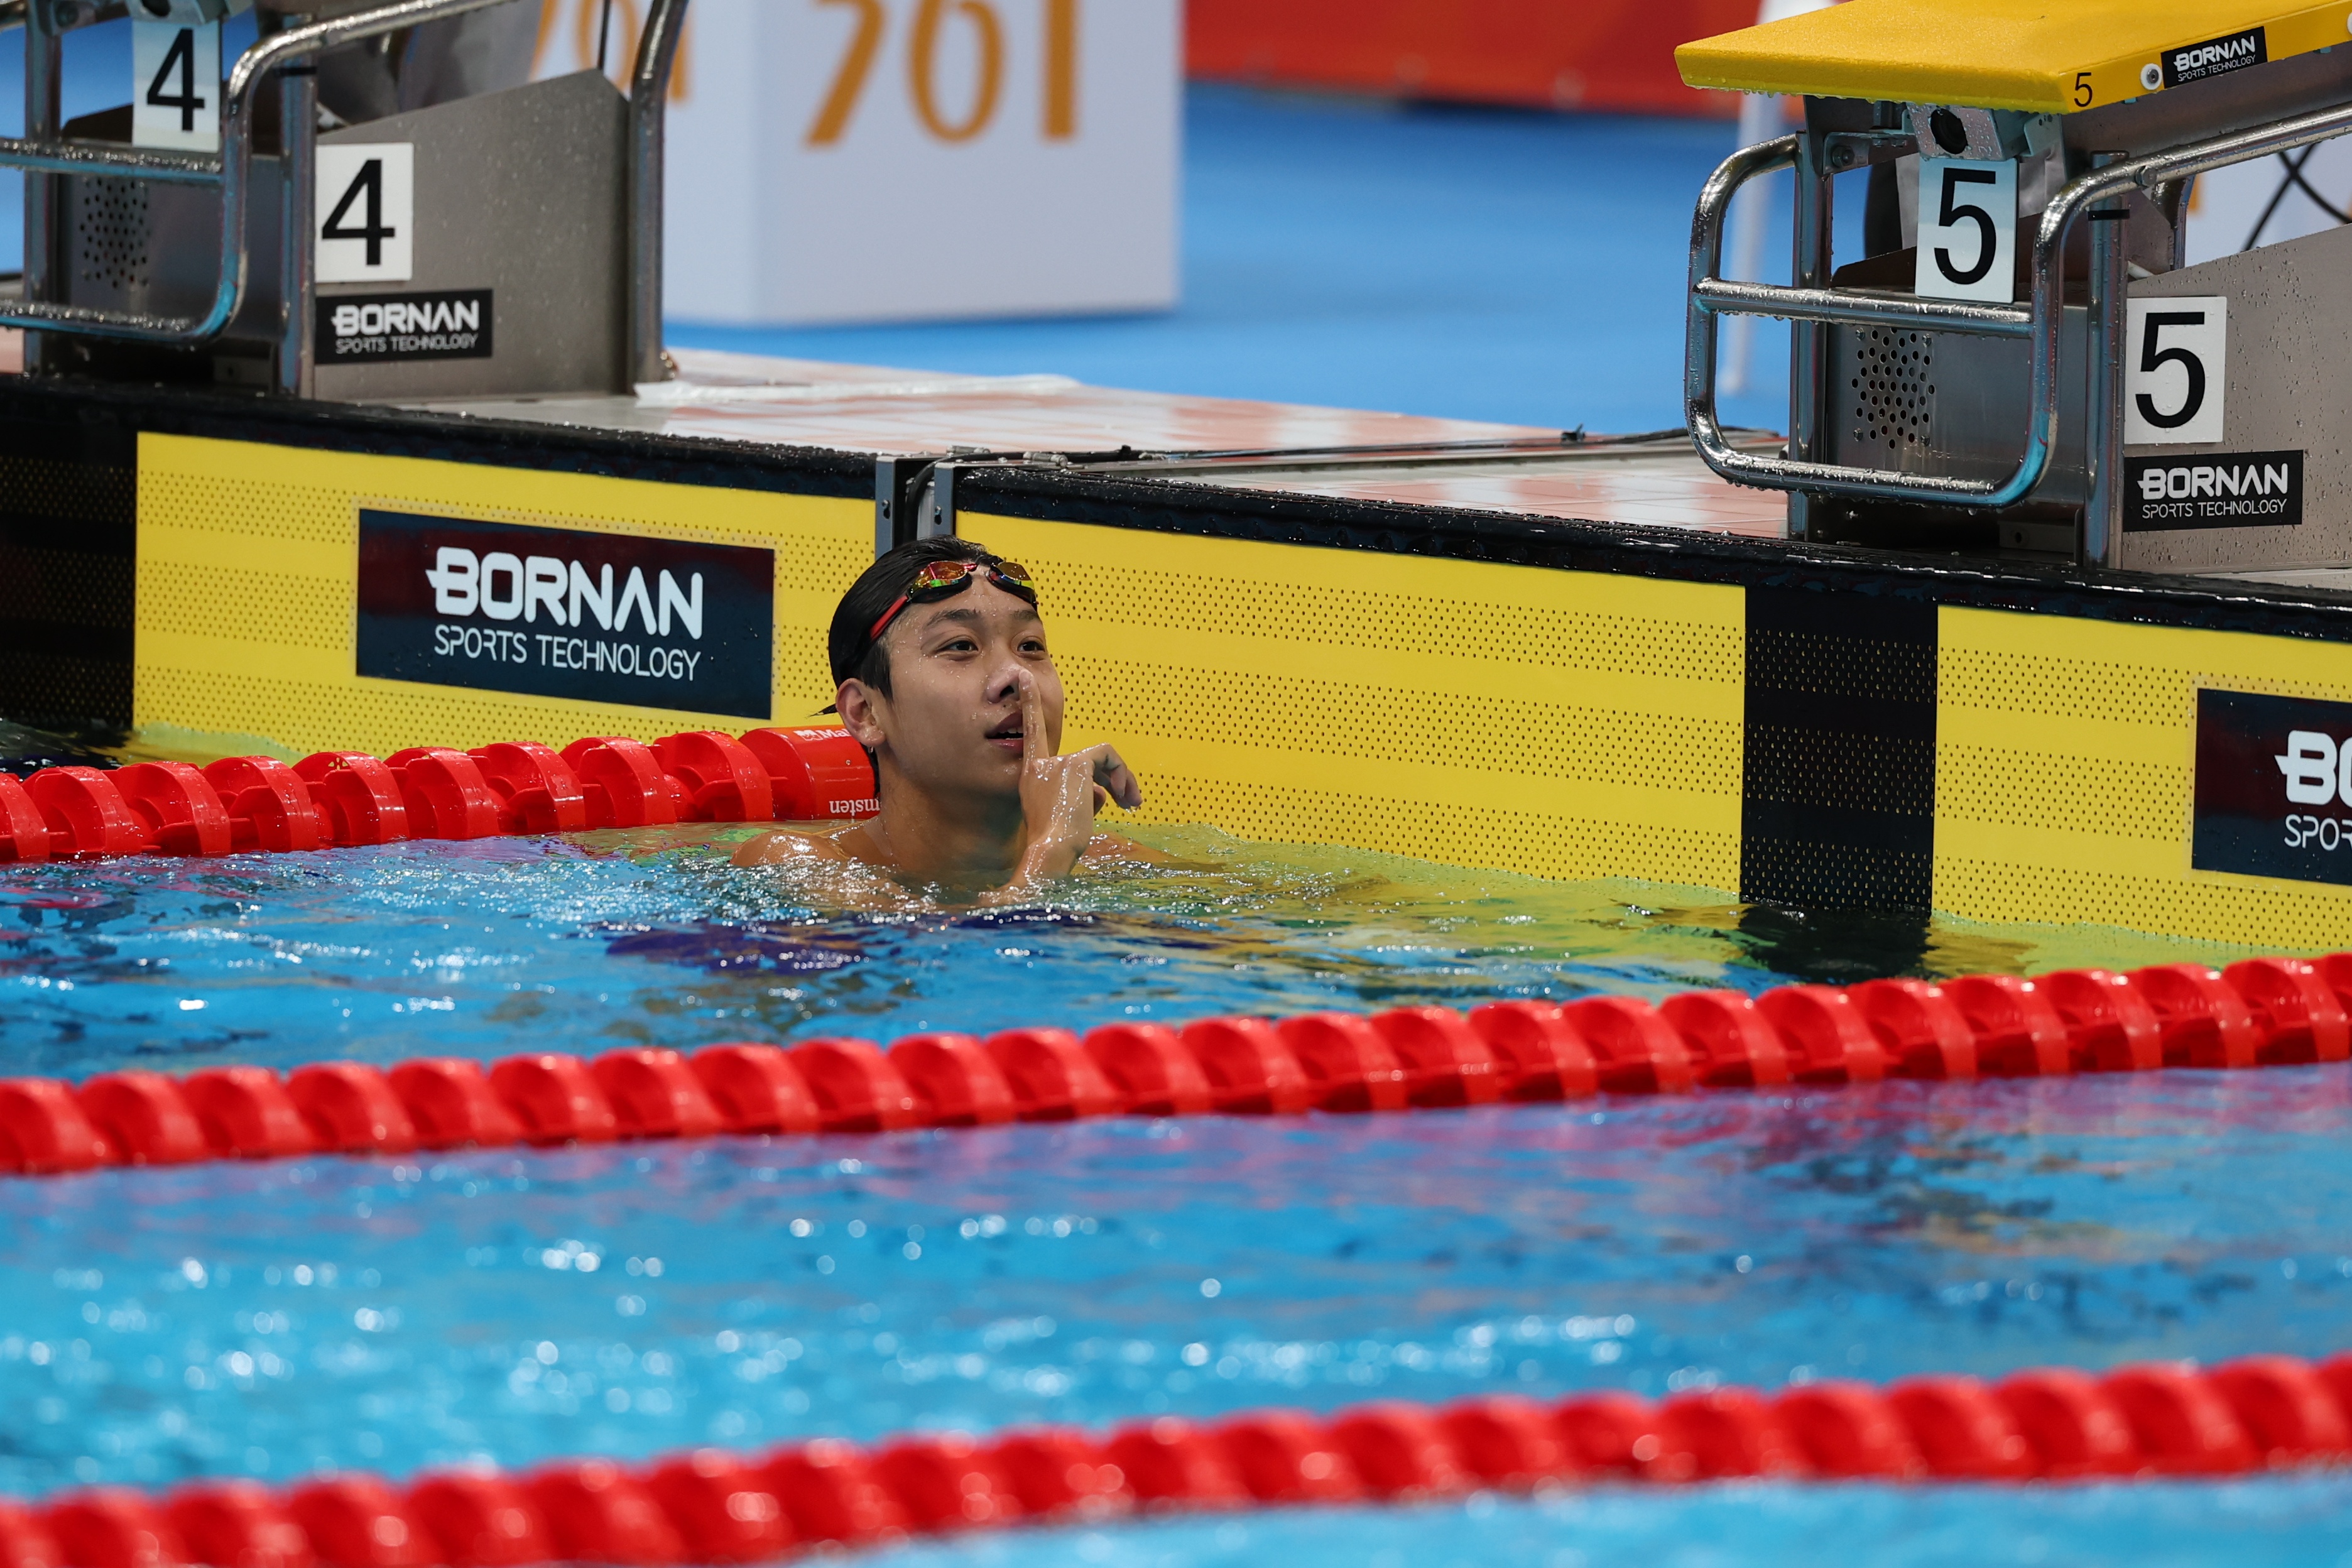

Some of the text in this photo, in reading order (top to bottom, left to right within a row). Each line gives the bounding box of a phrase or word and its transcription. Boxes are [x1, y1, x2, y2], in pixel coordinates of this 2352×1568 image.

[2173, 35, 2256, 72] BORNAN
[2178, 54, 2256, 82] SPORTS TECHNOLOGY
[147, 28, 205, 131] 4
[2074, 72, 2093, 107] 5
[322, 159, 395, 266] 4
[1934, 167, 1996, 285] 5
[330, 299, 479, 336] BORNAN
[335, 332, 479, 354] SPORTS TECHNOLOGY
[2135, 311, 2205, 428] 5
[2137, 463, 2288, 500] BORNAN
[2142, 499, 2287, 519] SPORTS TECHNOLOGY
[425, 546, 703, 640] BORNAN
[434, 624, 701, 681] SPORTS TECHNOLOGY
[2274, 730, 2352, 808] B
